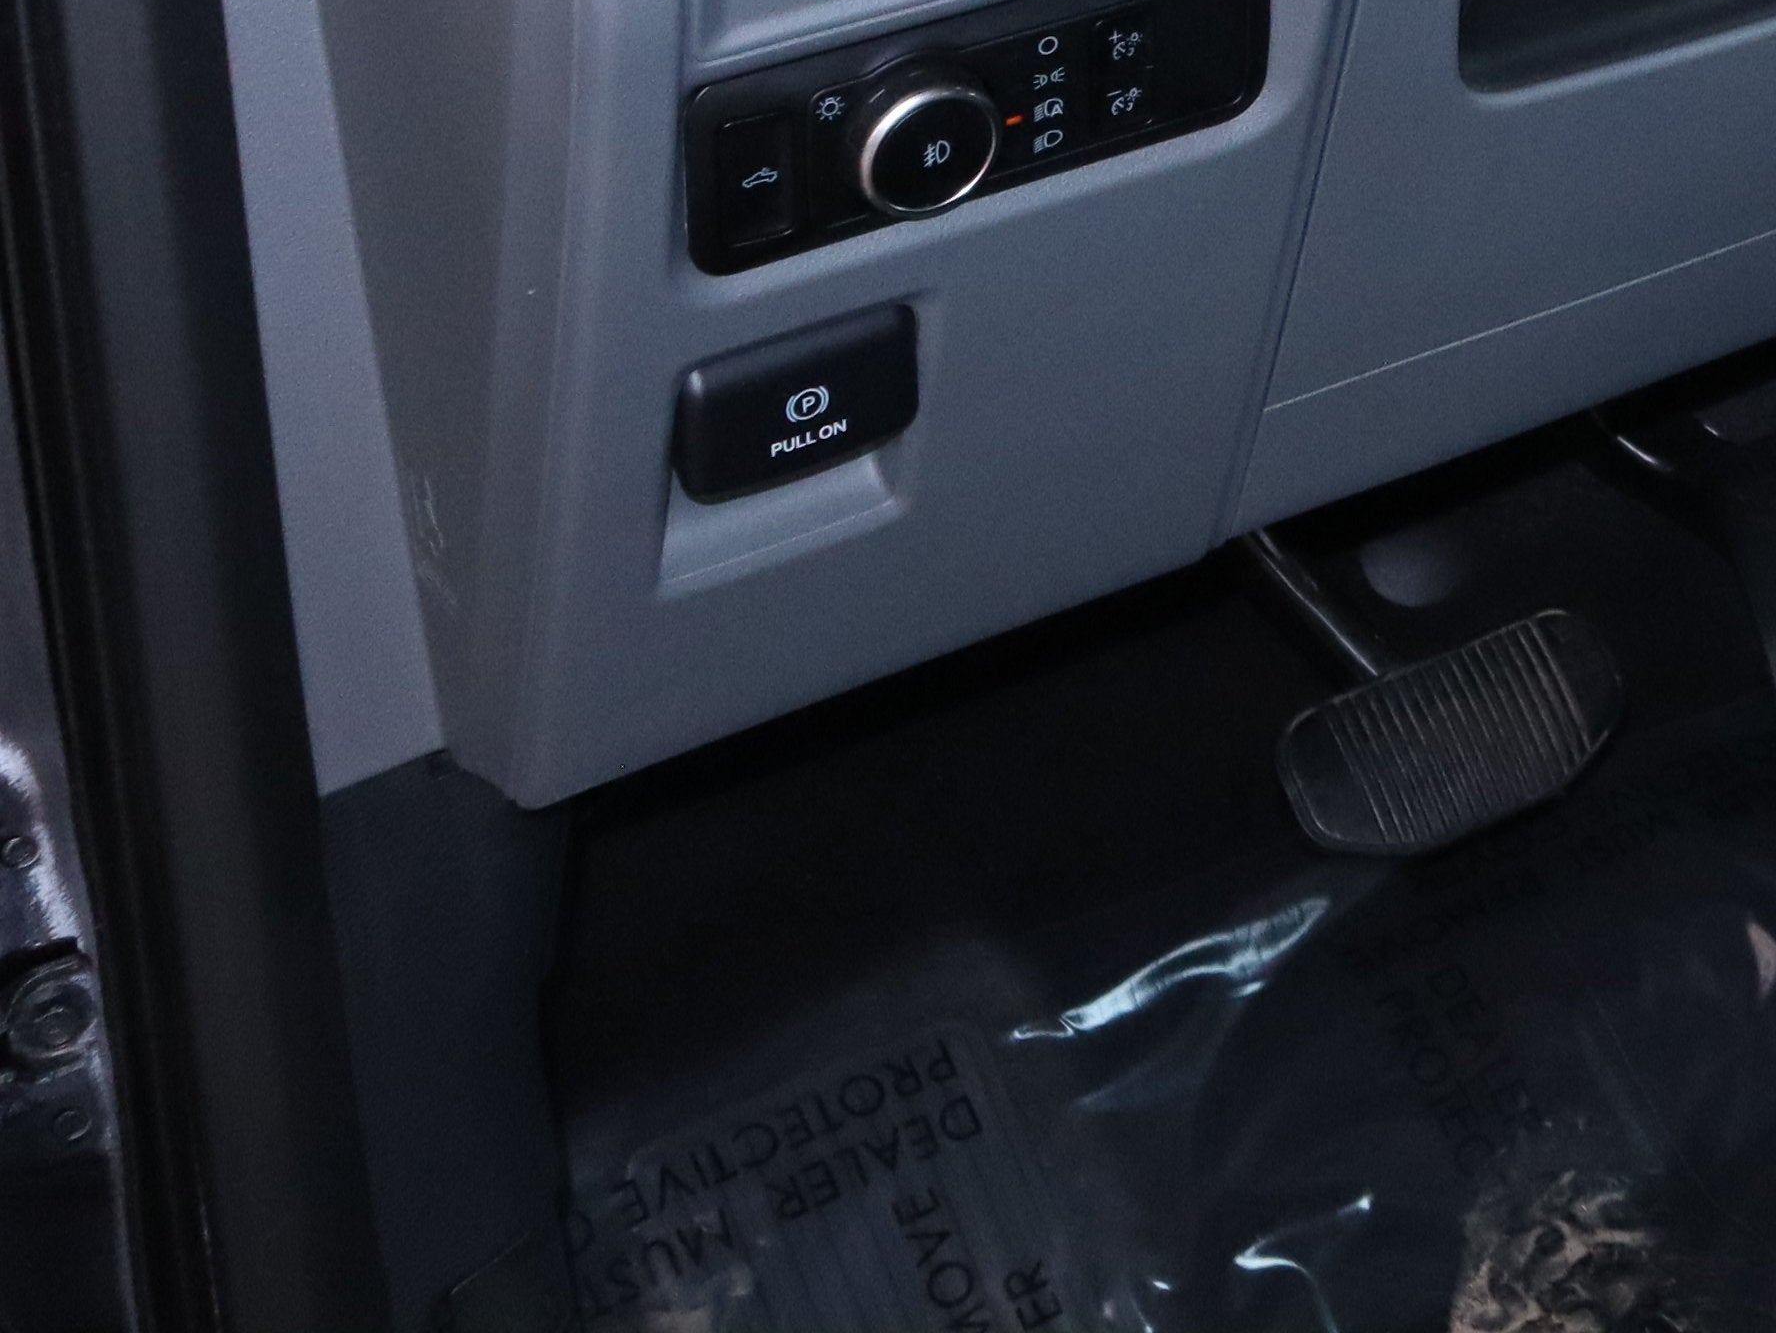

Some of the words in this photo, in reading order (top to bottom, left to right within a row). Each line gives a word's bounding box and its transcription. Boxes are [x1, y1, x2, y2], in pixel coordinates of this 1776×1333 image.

[770, 431, 817, 457] PULL
[819, 418, 847, 439] ON
[611, 1038, 958, 1230] PROTECTIVE
[766, 1094, 983, 1222] DEALER
